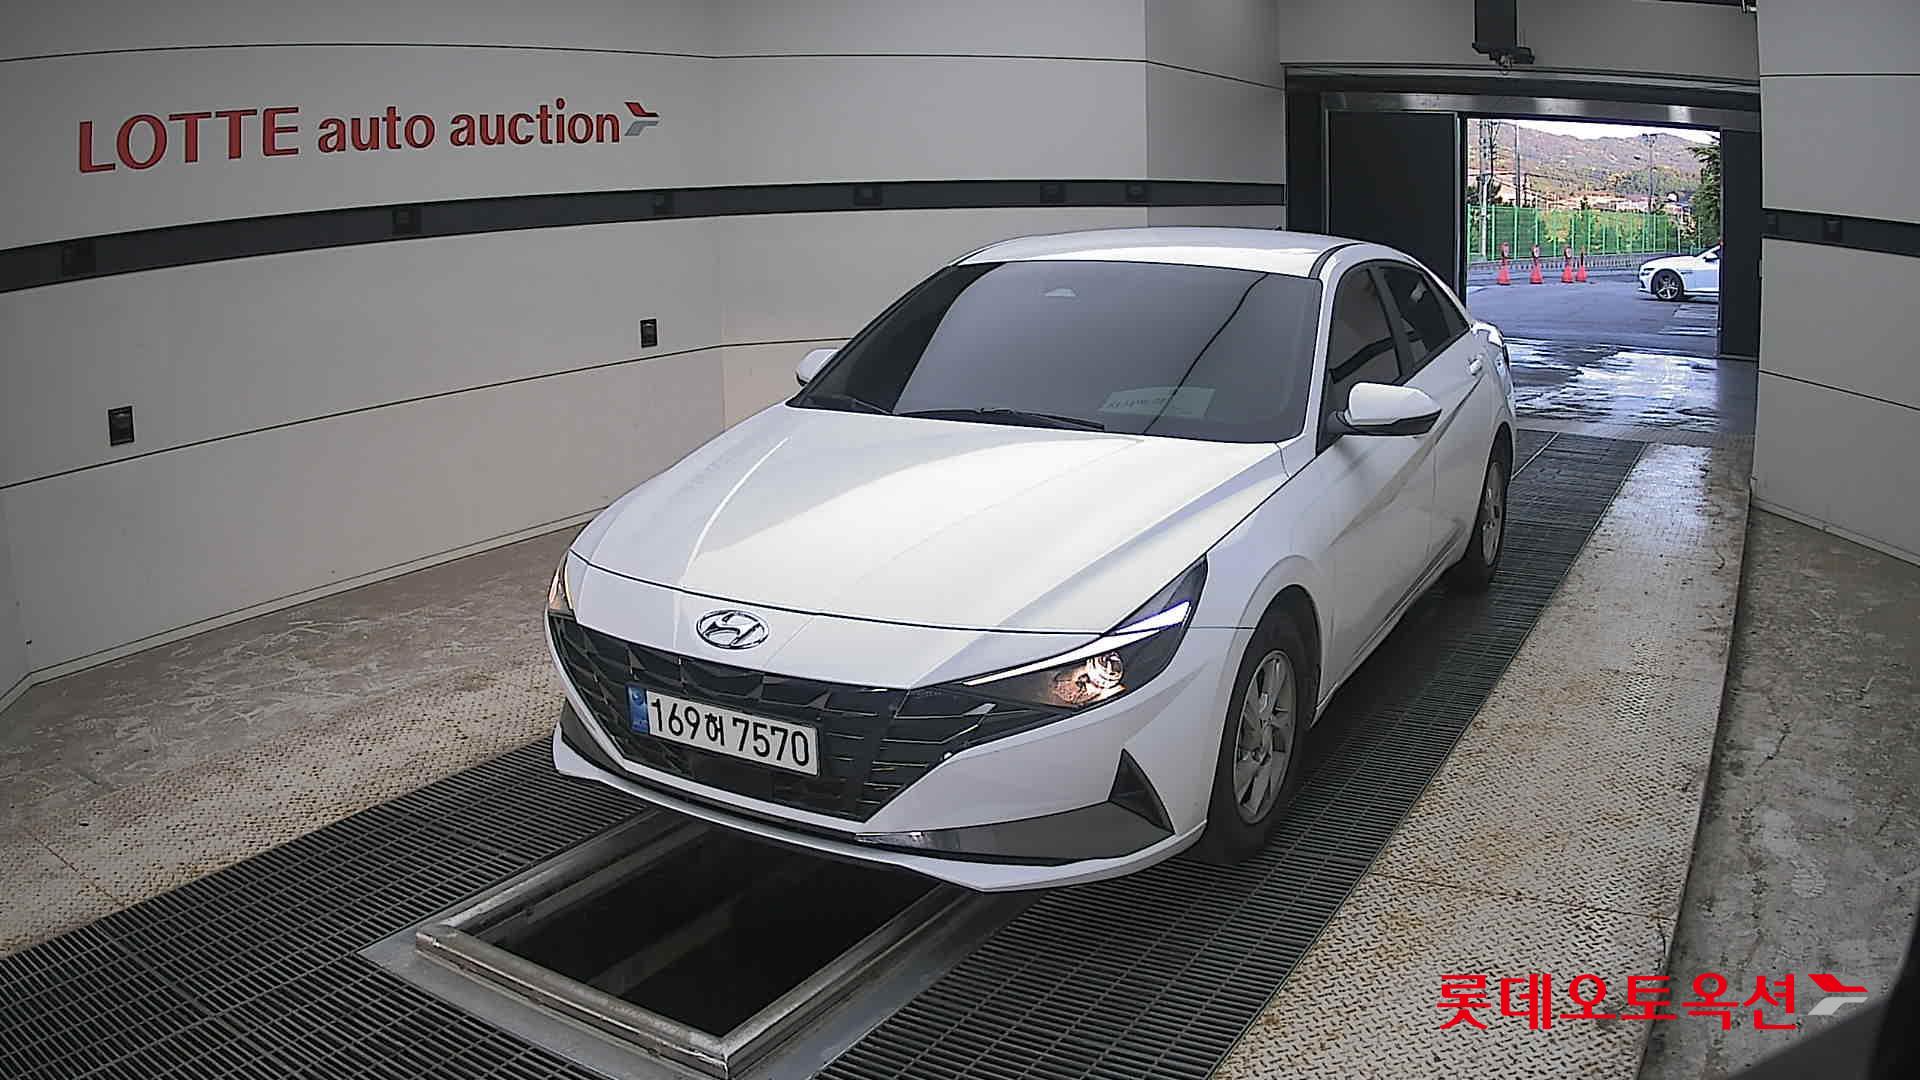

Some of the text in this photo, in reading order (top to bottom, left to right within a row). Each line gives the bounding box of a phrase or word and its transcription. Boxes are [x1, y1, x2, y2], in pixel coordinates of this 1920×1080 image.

[79, 98, 621, 173] LOTTE auto auction
[732, 717, 810, 767] 7570
